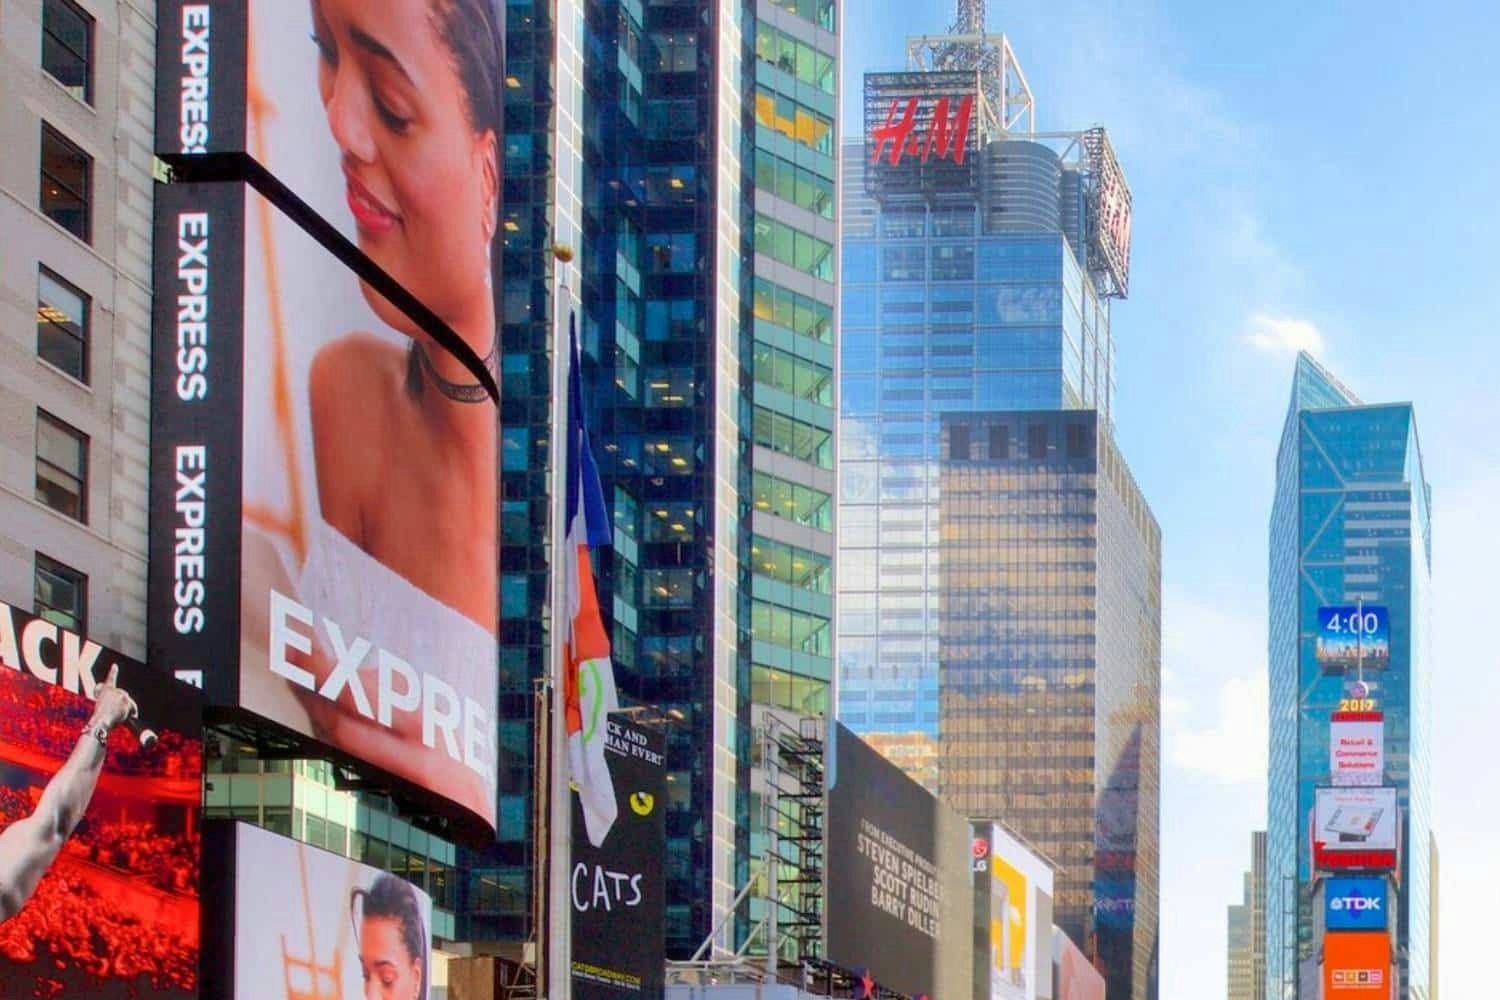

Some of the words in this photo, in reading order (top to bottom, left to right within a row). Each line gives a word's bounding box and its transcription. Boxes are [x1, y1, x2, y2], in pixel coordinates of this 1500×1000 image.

[177, 212, 209, 402] EXPRESS
[173, 445, 207, 634] EXPRESS
[1327, 613, 1378, 634] 4:00
[571, 862, 643, 912] CATS
[873, 868, 907, 902] SCOTT
[1342, 897, 1381, 911] TDK
